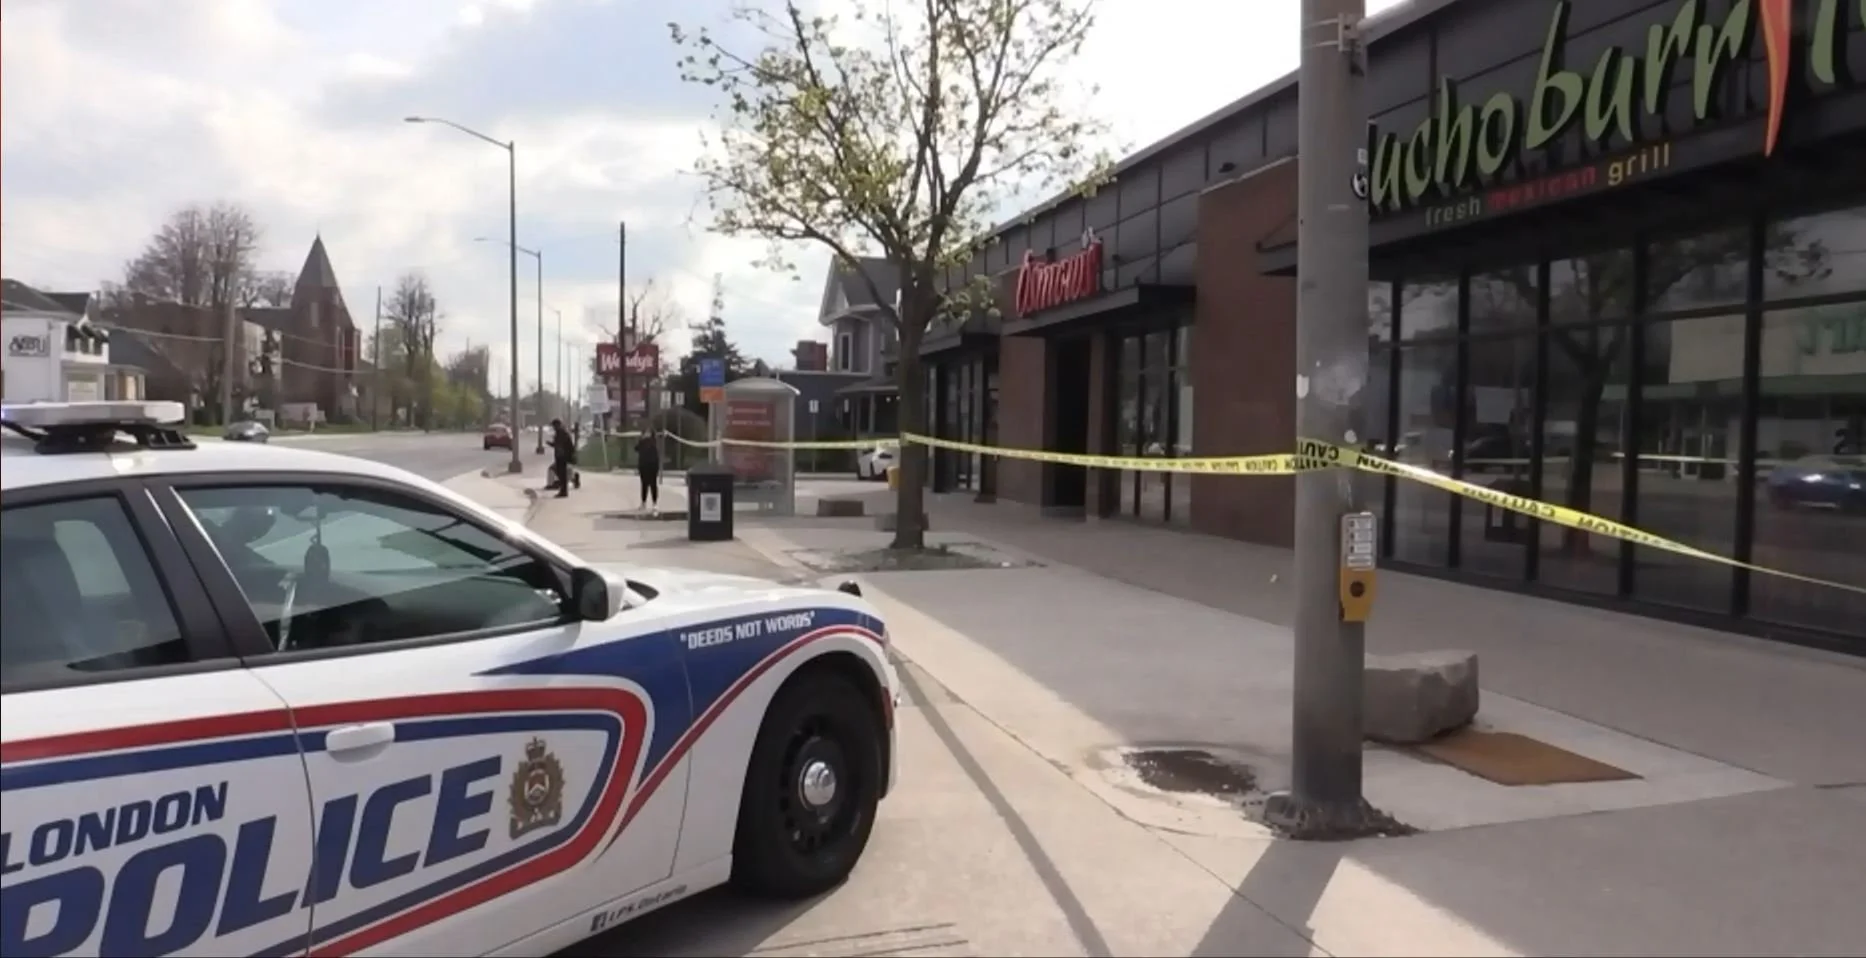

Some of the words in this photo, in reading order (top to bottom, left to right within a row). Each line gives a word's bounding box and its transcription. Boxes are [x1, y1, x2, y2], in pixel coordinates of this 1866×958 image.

[1368, 75, 1515, 208] ucho
[1608, 142, 1670, 186] grill
[735, 620, 763, 641] NOT
[0, 780, 228, 876] LONDON
[0, 755, 503, 958] POLICE
